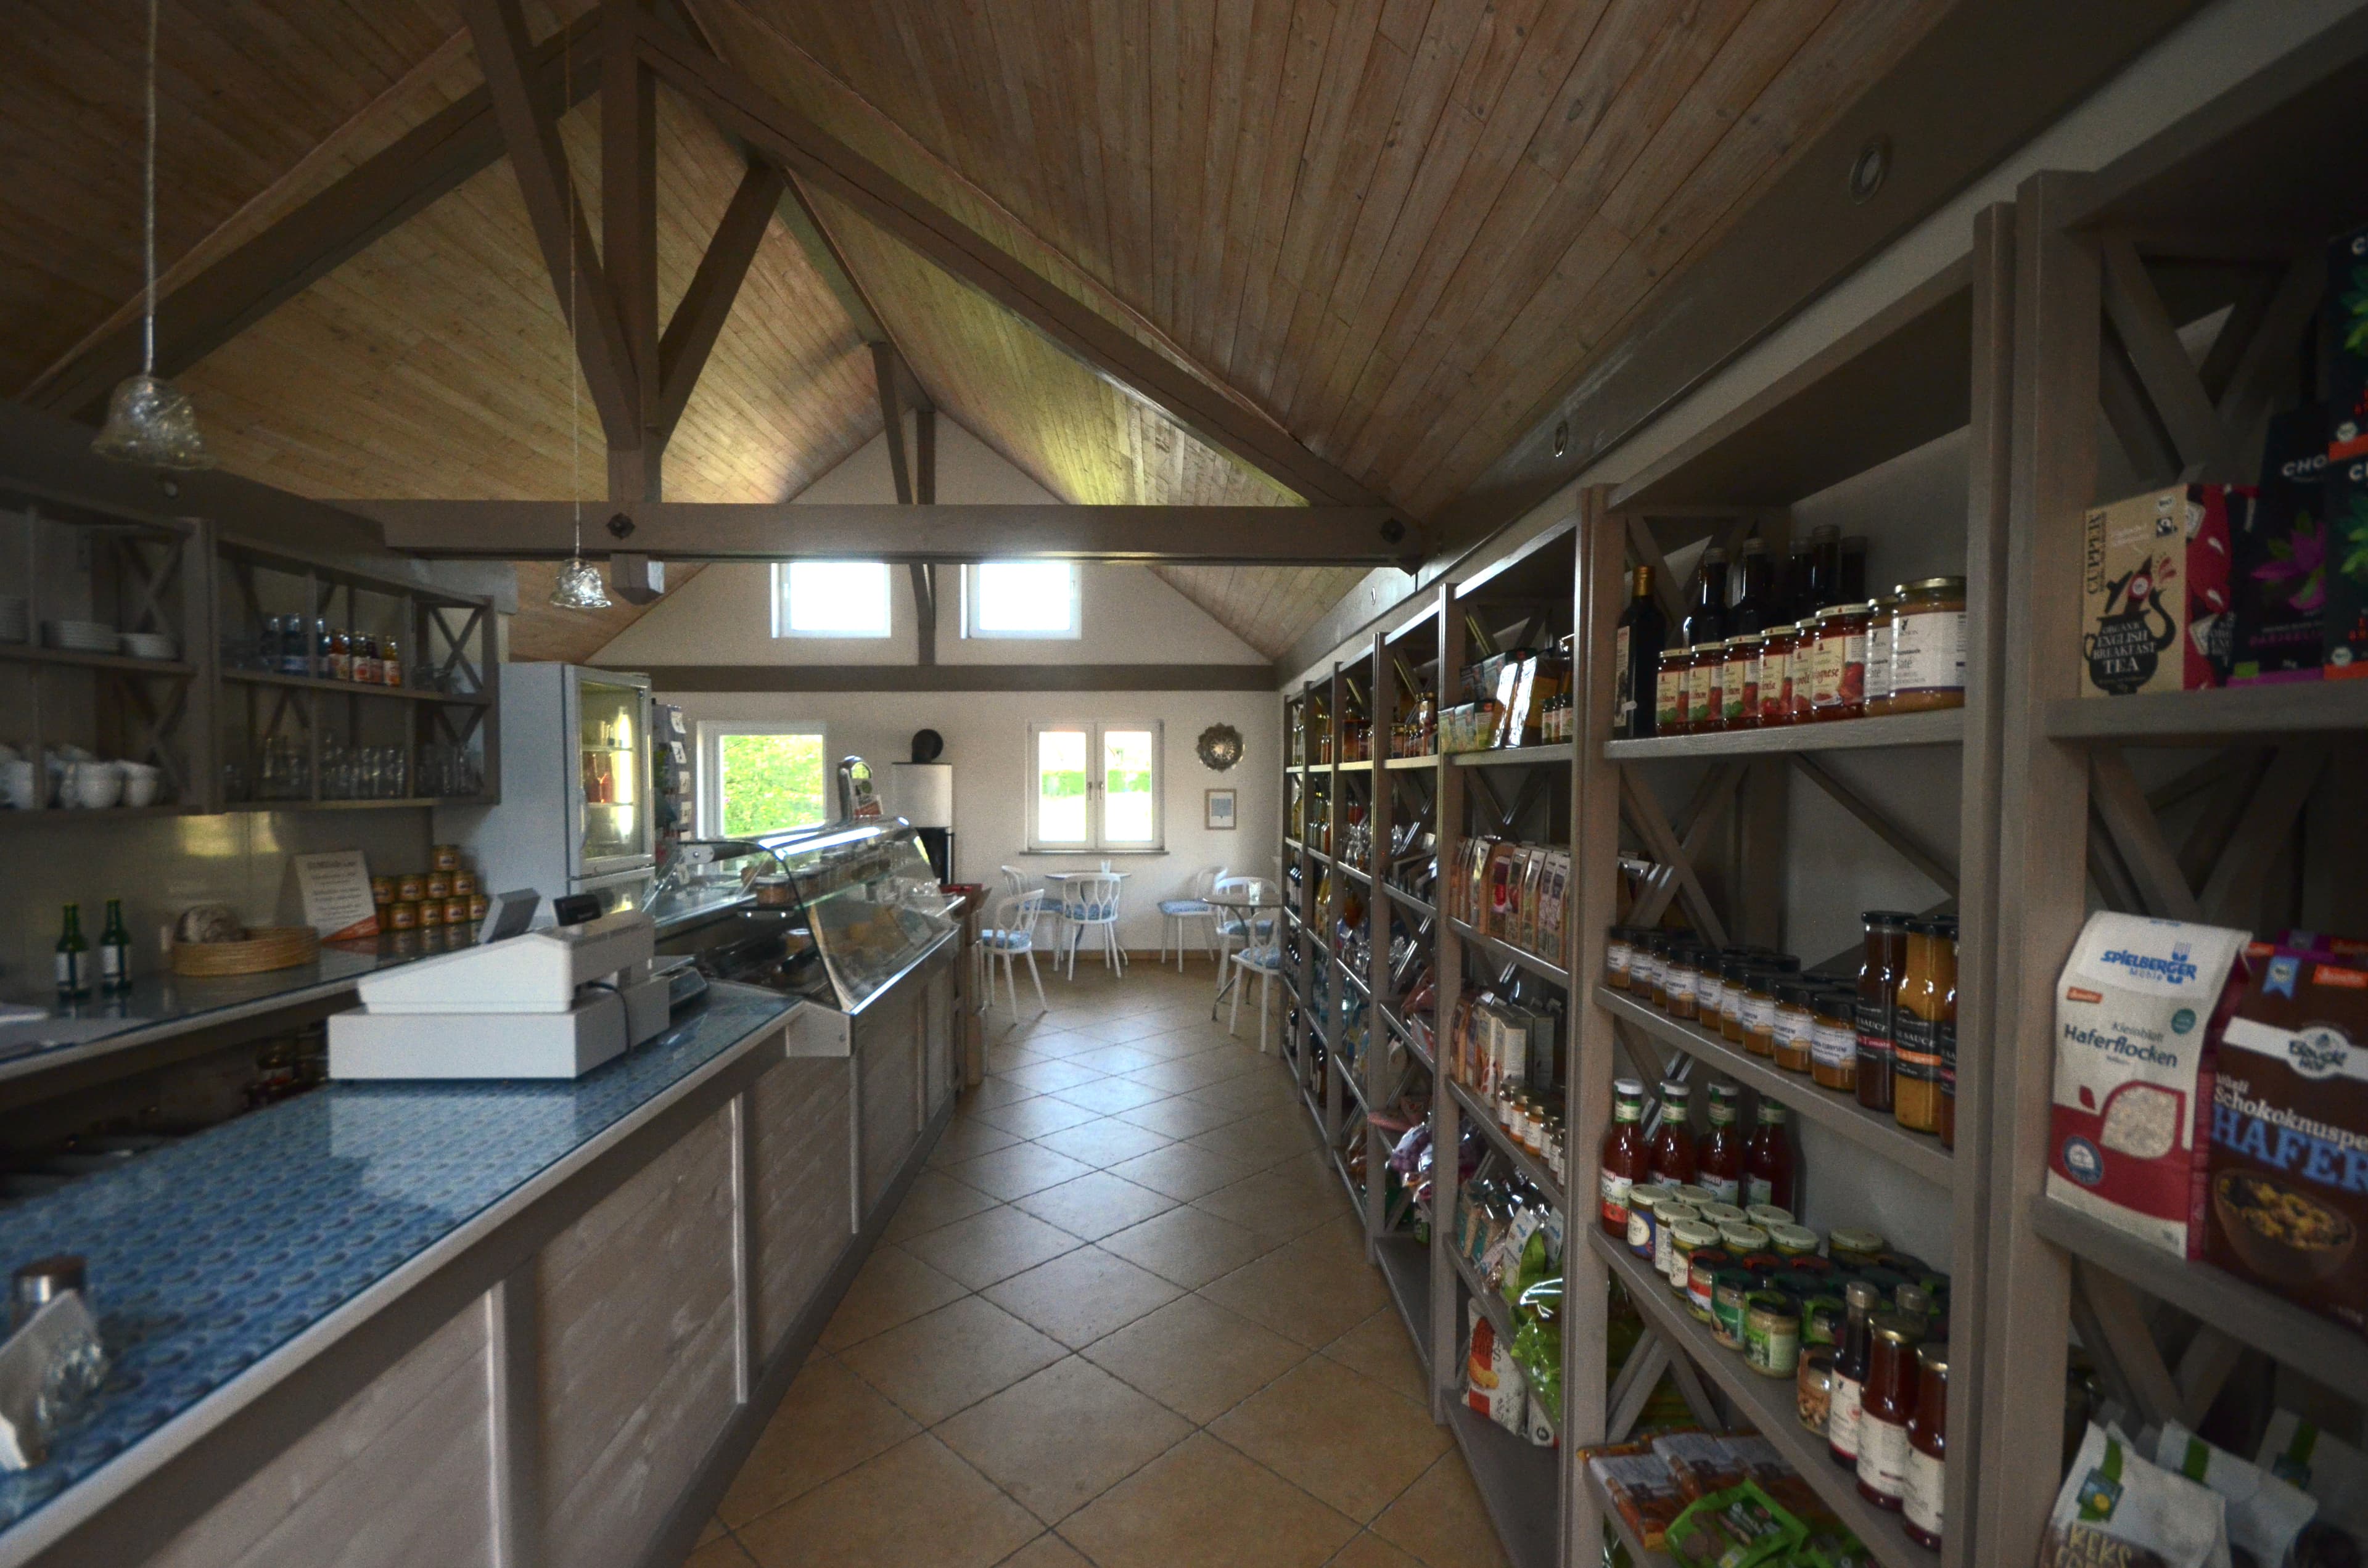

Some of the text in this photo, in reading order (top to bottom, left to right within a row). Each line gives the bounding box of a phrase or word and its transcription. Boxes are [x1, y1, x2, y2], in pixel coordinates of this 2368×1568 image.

[2087, 513, 2102, 594] CUPPER
[2097, 630, 2148, 647] ENGLISH
[2092, 641, 2156, 660] BREAKFAST
[2103, 656, 2140, 675] TEA
[2100, 950, 2197, 980] SPIELBERGER
[1904, 1032, 1936, 1048] SAUCE
[2064, 1024, 2178, 1068] Haferflocken
